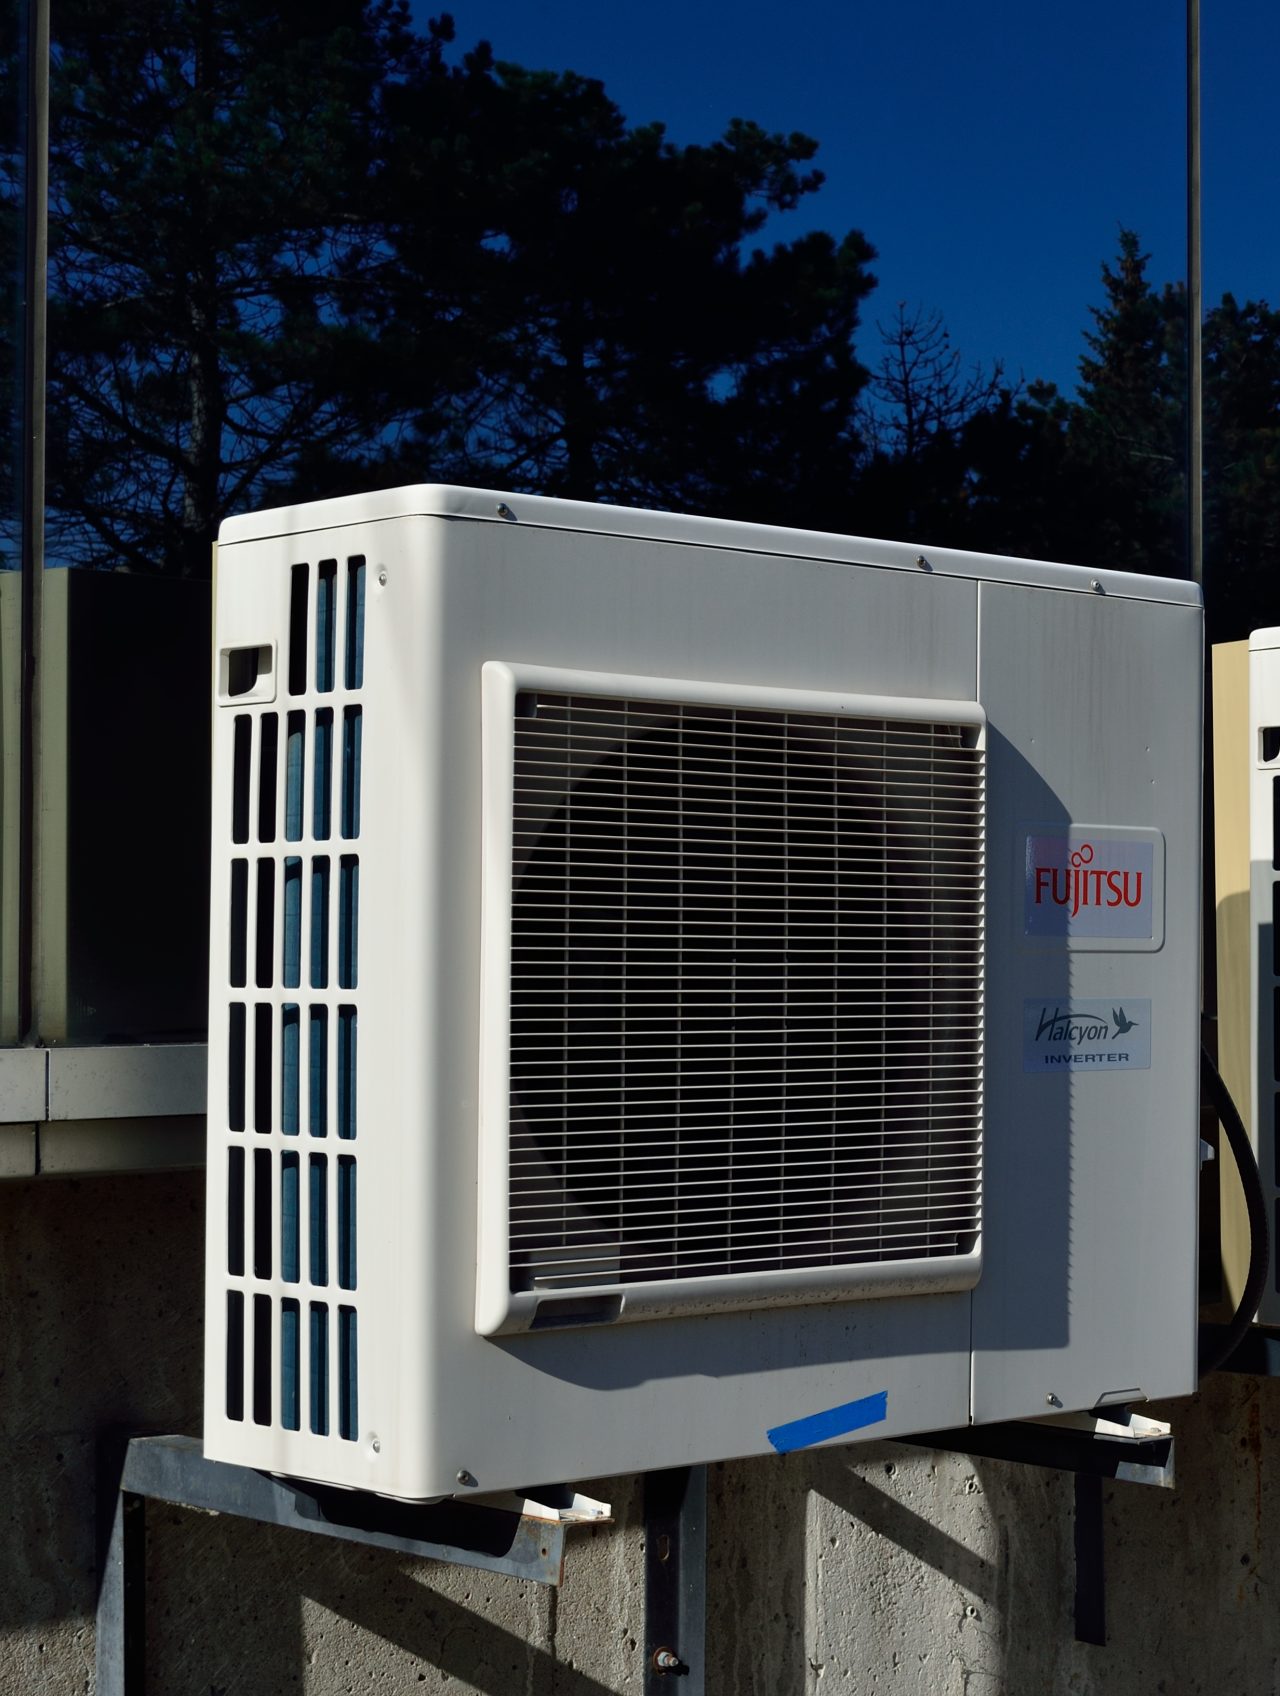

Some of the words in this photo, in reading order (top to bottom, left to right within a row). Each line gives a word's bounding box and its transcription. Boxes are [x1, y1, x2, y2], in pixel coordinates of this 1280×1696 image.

[1034, 844, 1143, 918] FUJITSU
[1034, 1006, 1109, 1046] Halcyon
[1045, 1052, 1130, 1064] INVERTER
